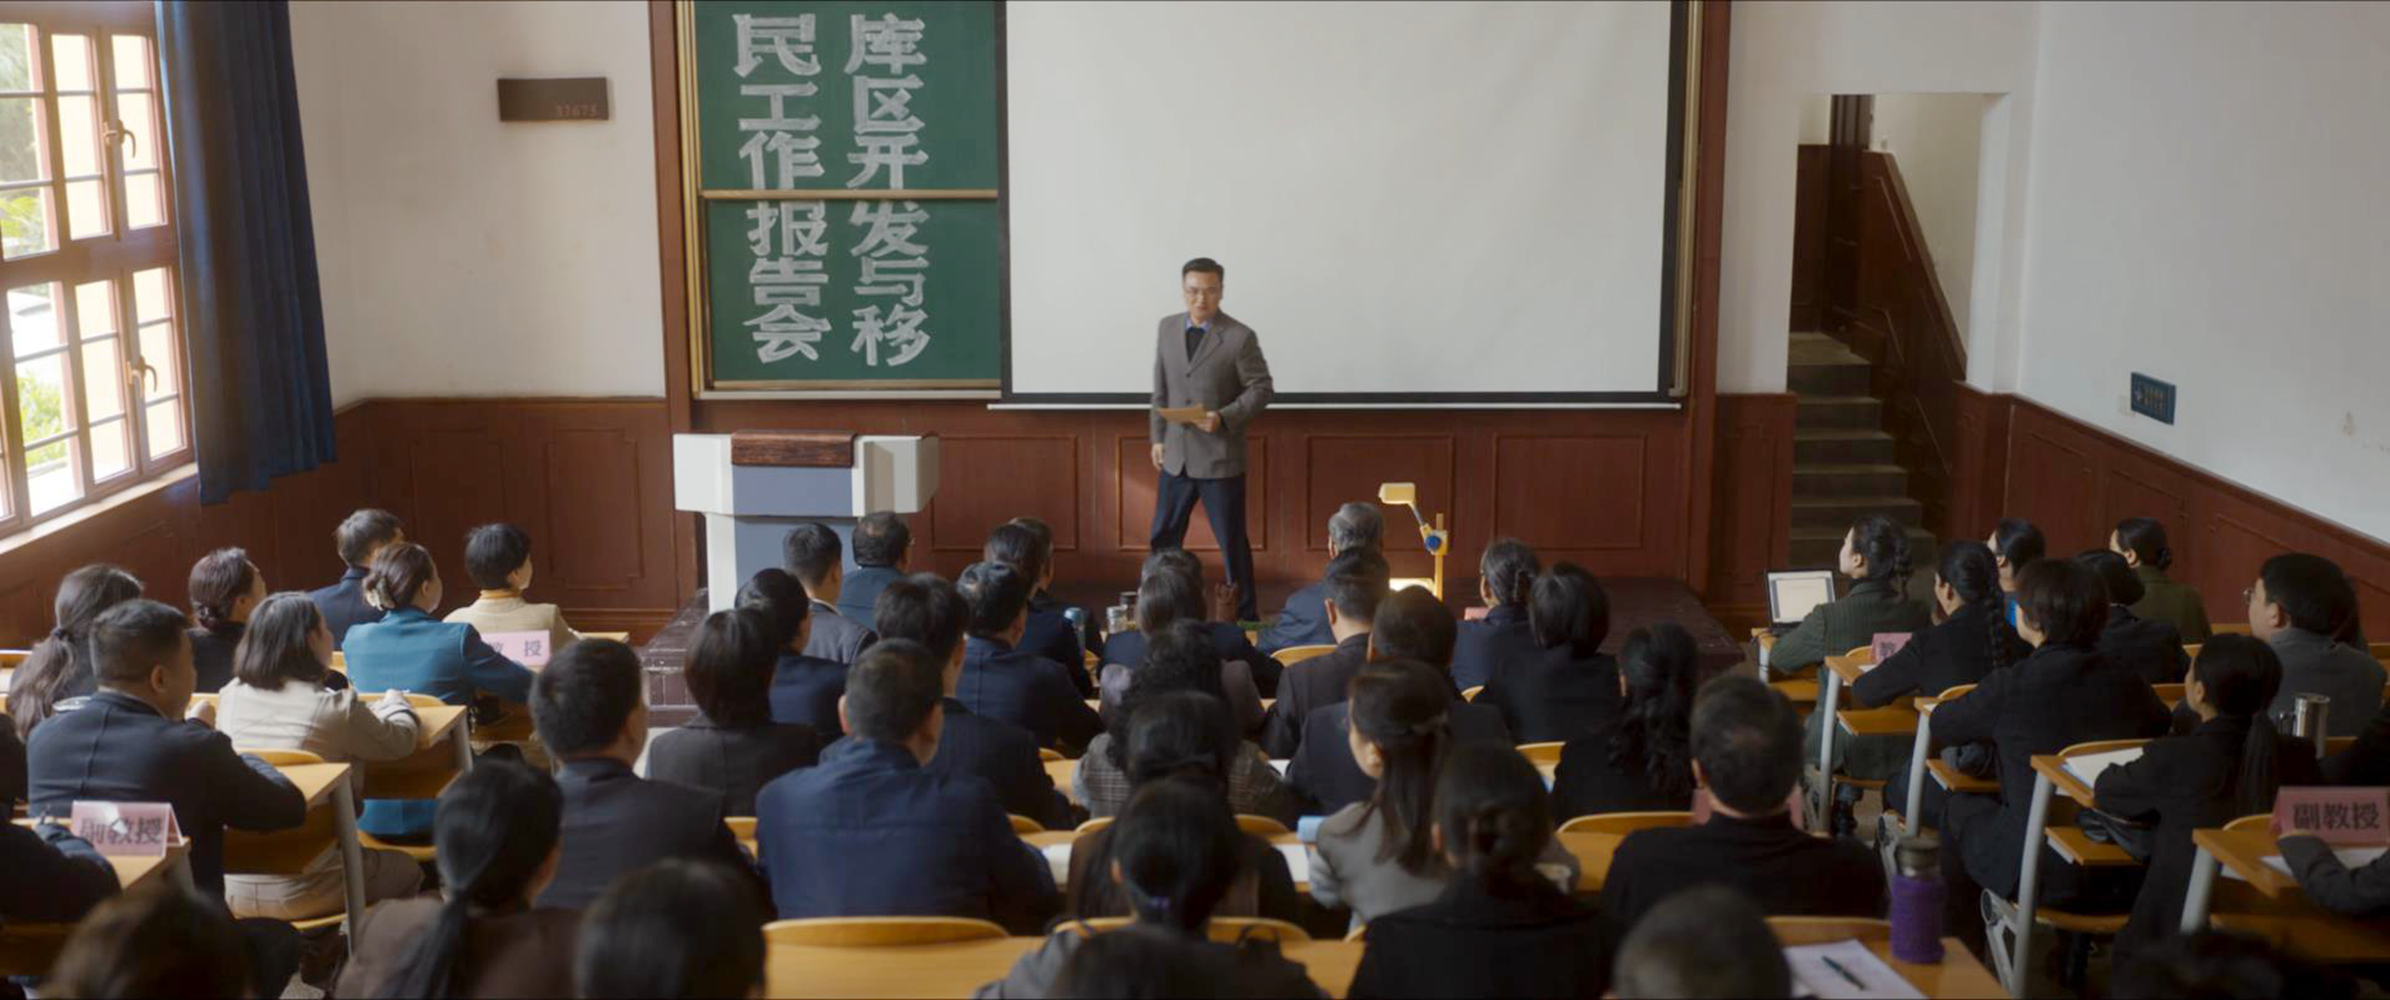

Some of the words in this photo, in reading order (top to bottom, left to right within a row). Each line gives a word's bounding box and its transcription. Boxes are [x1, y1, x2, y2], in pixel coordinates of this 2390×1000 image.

[732, 13, 832, 364] 民工作报告会
[844, 12, 930, 366] 库区开发与移
[2293, 802, 2379, 831] 副教授
